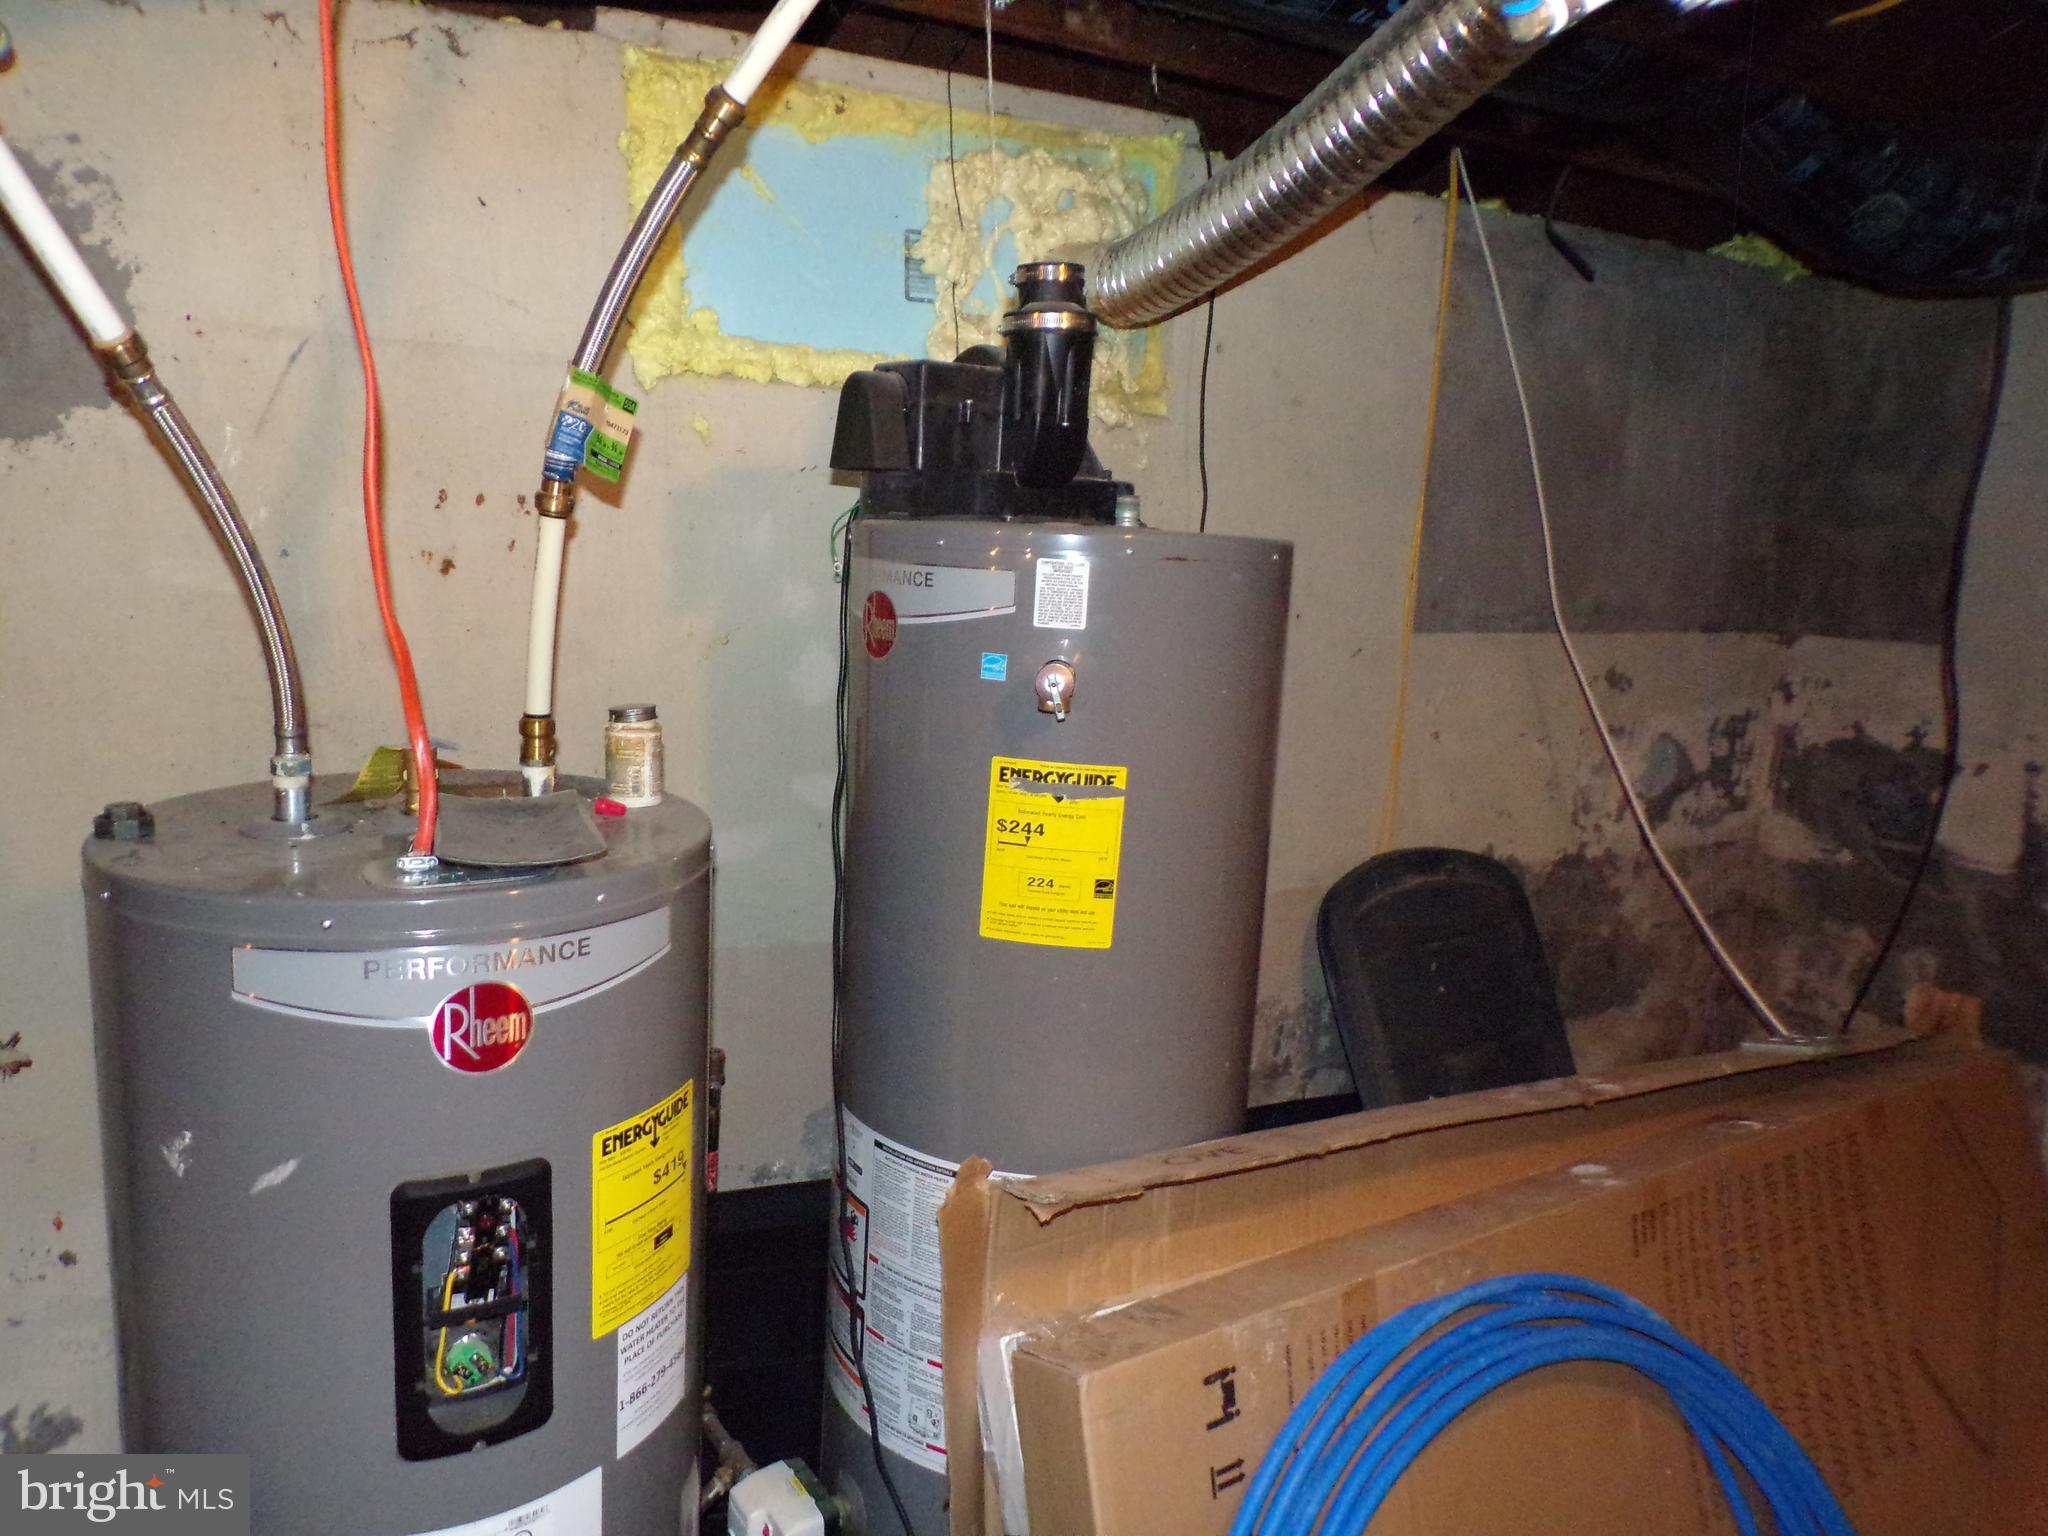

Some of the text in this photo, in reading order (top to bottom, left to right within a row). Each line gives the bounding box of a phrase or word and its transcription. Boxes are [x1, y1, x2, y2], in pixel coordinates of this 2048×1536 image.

[996, 818, 1045, 836] $244
[1027, 876, 1055, 888] 224
[363, 936, 592, 980] PERFORMANCE
[443, 986, 528, 1061] Rheem
[601, 1089, 689, 1157] ENERGYGUIDE
[653, 1150, 684, 1184] $419
[620, 1334, 645, 1355] WATER
[646, 1314, 668, 1337] HEATER
[622, 1329, 634, 1341] DO
[635, 1318, 649, 1333] NOT
[651, 1298, 673, 1320] RETURN
[624, 1345, 645, 1365] PLACE
[646, 1337, 655, 1348] OF
